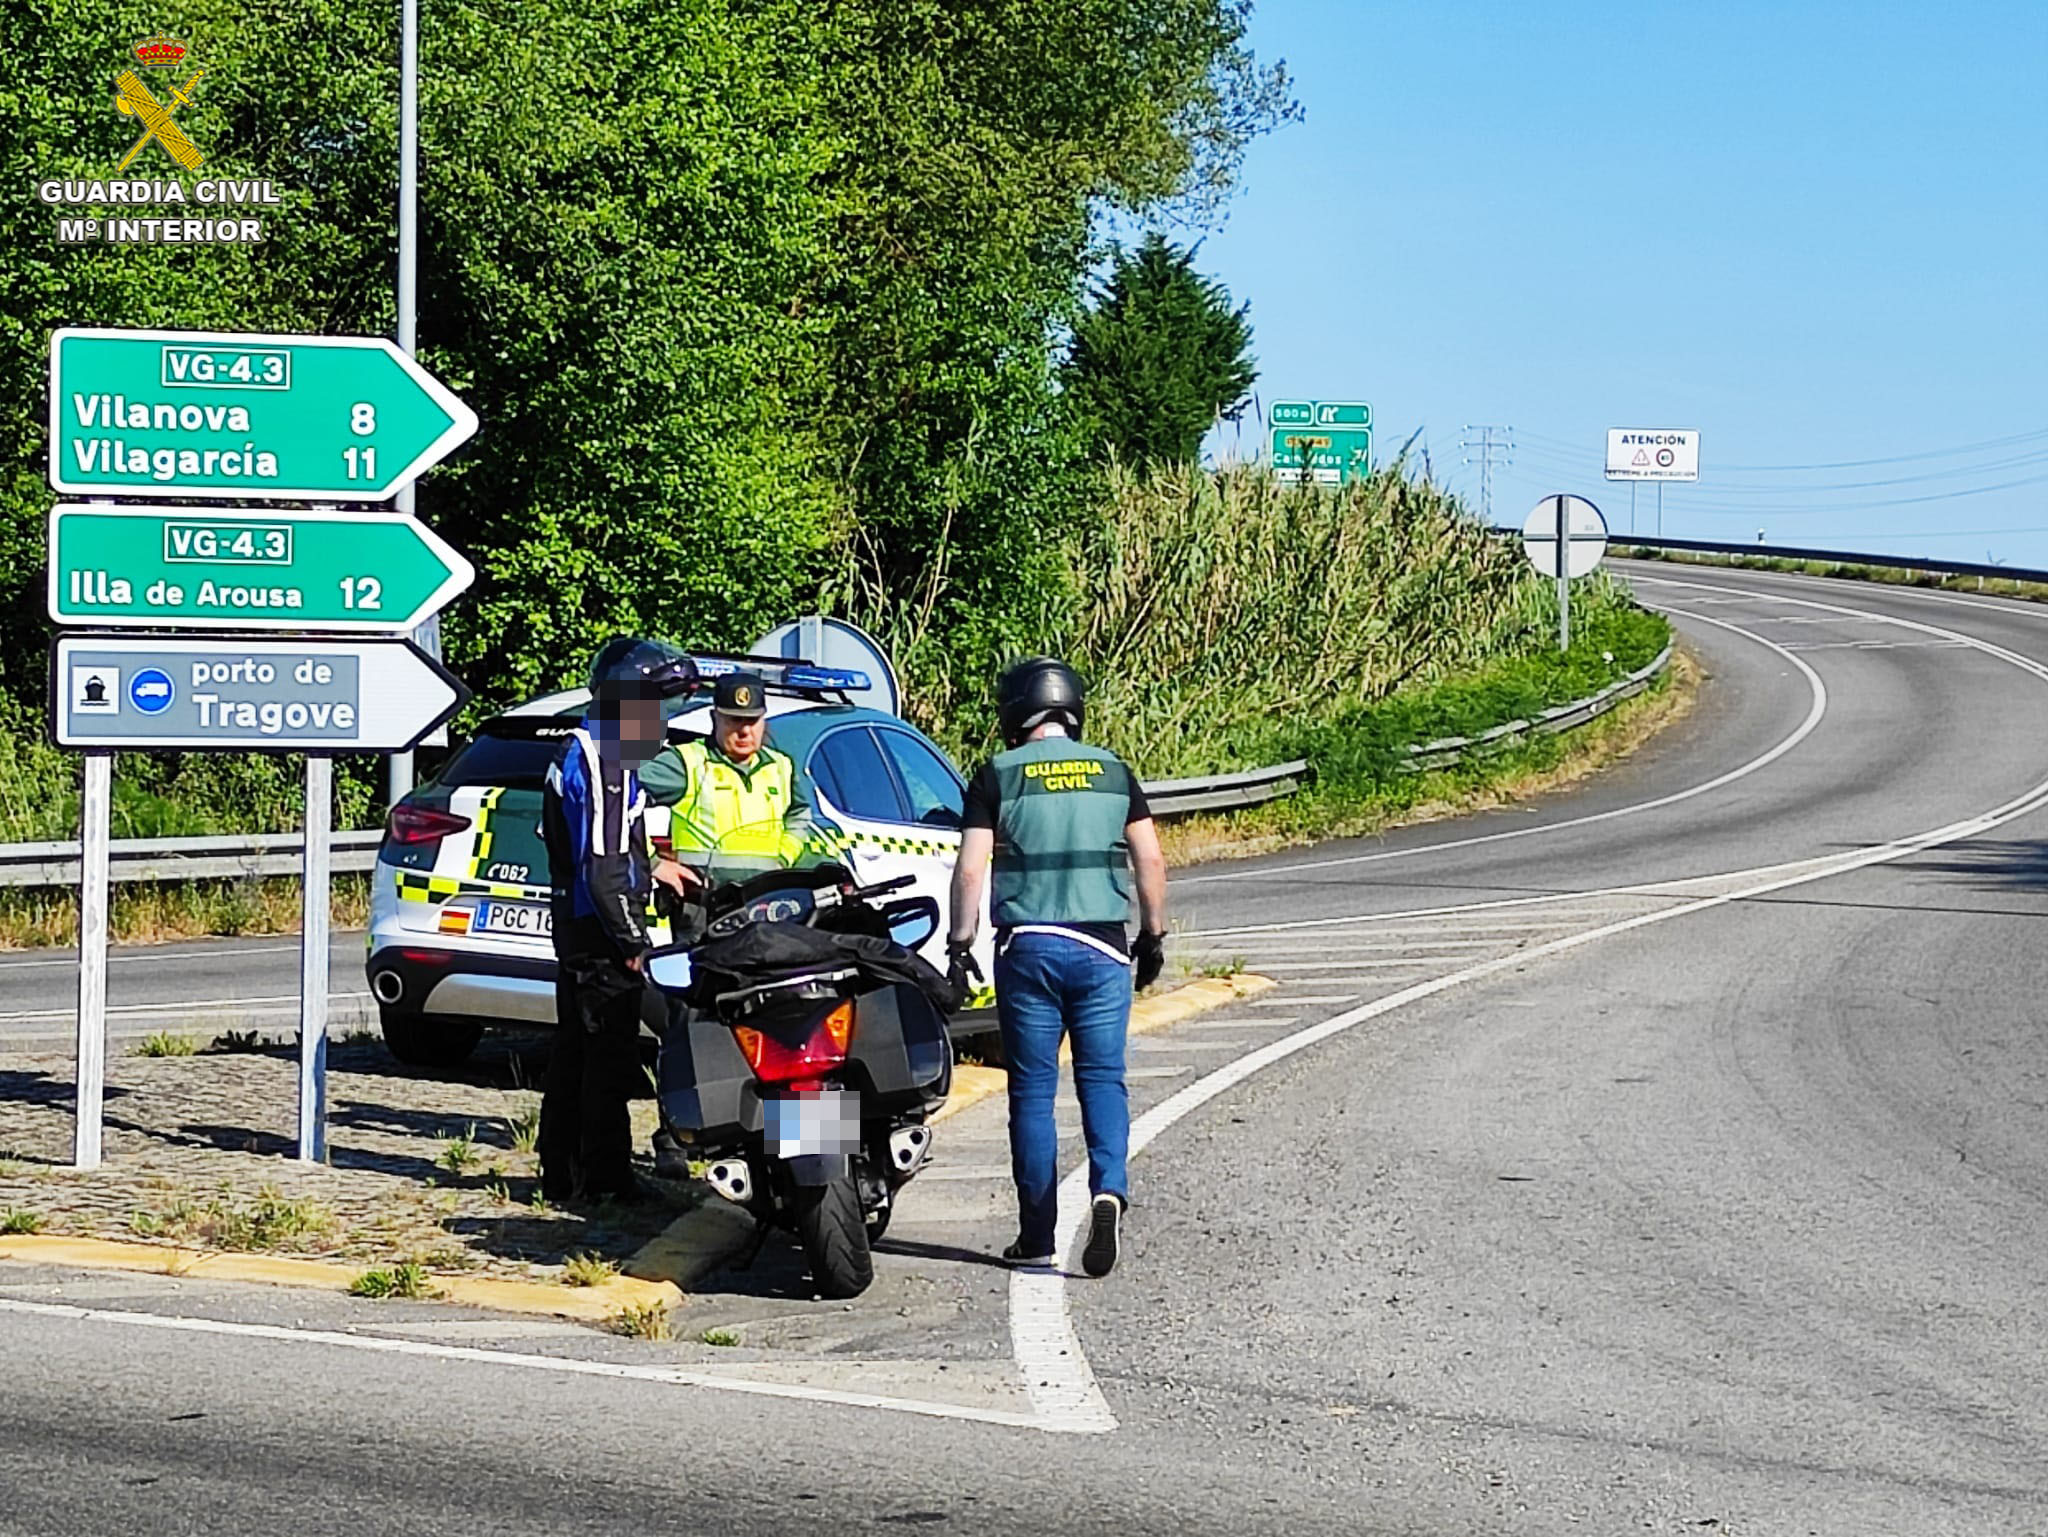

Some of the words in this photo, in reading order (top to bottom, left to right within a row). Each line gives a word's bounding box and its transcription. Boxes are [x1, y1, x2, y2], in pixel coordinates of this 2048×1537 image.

[169, 353, 284, 383] VG-4.3
[73, 394, 250, 432] Vilanova
[350, 402, 377, 435] 8
[72, 439, 279, 481] Vilagarcía
[342, 446, 377, 480] 11
[172, 529, 286, 559] VG-4.3
[69, 571, 133, 604] Illa
[146, 580, 184, 606] de
[196, 581, 303, 608] Arousa
[340, 577, 382, 609] 12
[191, 659, 275, 687] porto
[294, 659, 333, 684] de
[191, 693, 356, 733] Tragove
[1024, 760, 1105, 778] GUARDIA
[1045, 774, 1093, 790] CIVIL
[499, 864, 528, 882] 062
[490, 905, 530, 929] PGC
